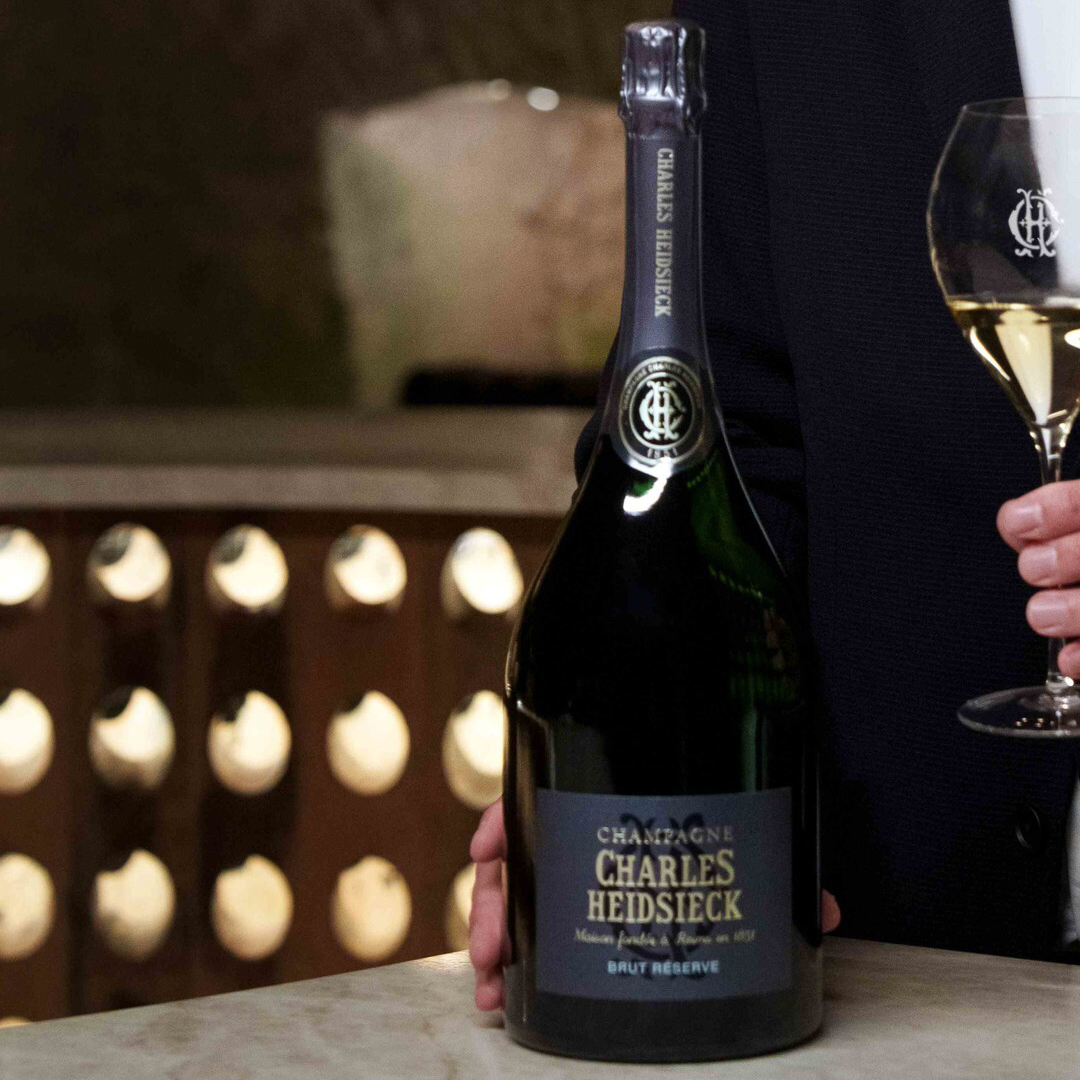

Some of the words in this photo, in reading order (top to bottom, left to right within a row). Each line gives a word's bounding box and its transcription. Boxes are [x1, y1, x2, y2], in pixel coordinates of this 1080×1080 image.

[656, 147, 674, 223] CHARLES
[654, 229, 673, 317] HEIDSIECK
[597, 826, 734, 845] CHAMPAGNE
[595, 849, 735, 888] CHARLES
[587, 889, 743, 924] HEIDSIECK
[607, 960, 647, 975] BRUT
